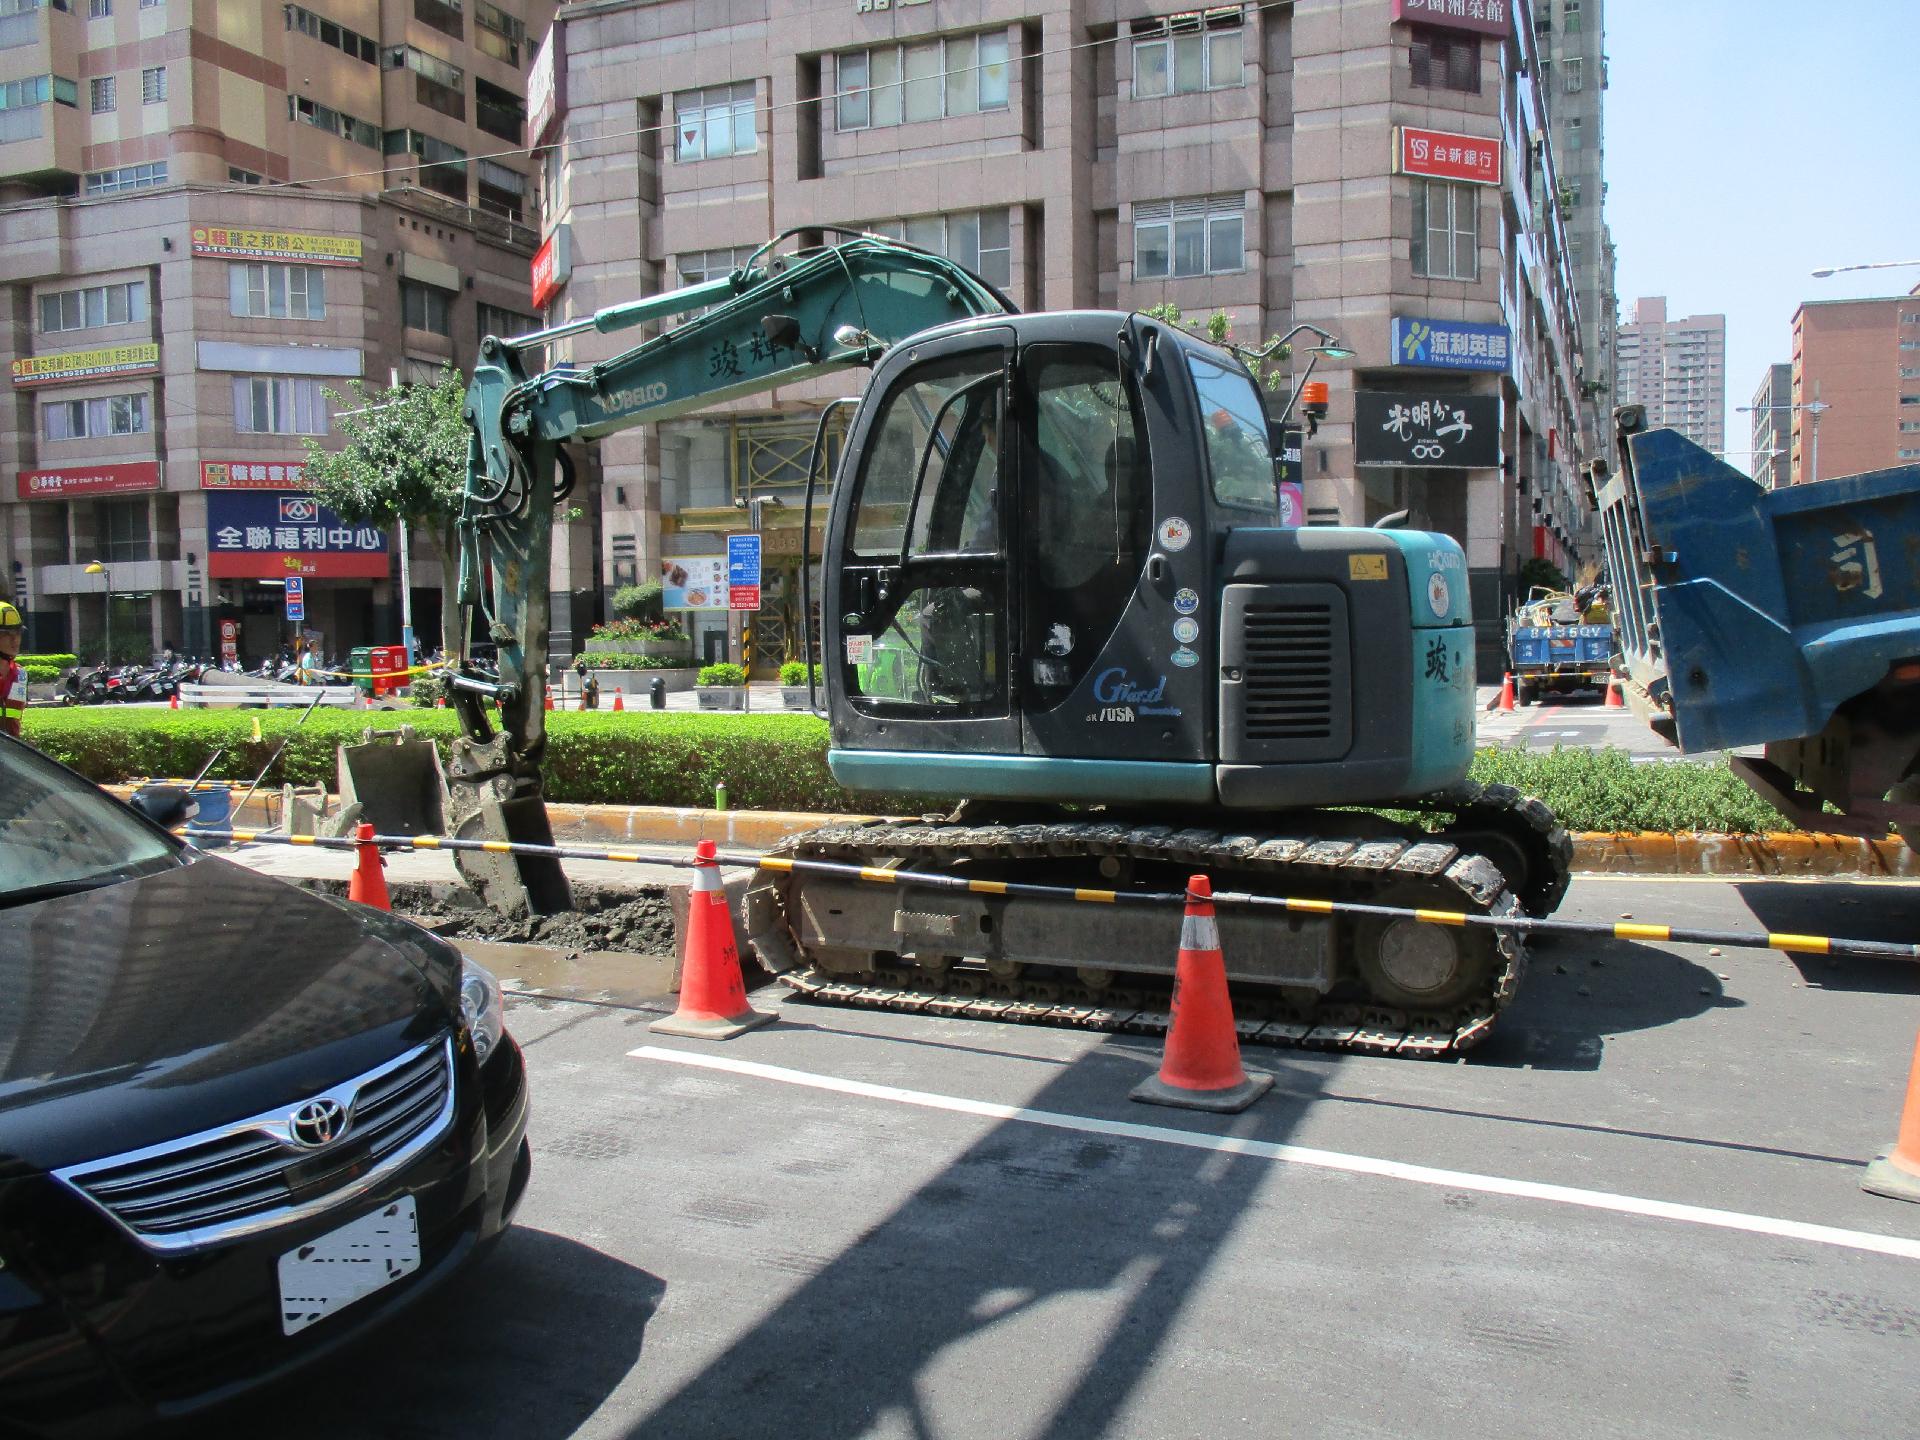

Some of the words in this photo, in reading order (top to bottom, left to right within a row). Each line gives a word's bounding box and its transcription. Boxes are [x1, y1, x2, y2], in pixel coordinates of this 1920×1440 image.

[1433, 145, 1492, 168] 台新銀行
[1430, 331, 1507, 358] 流利英語
[1430, 354, 1444, 362] The
[1445, 355, 1473, 365] English
[1474, 358, 1506, 368] Academy
[216, 525, 381, 550] 全聯福利中心
[768, 538, 799, 550] 239
[1830, 529, 1883, 599] 司
